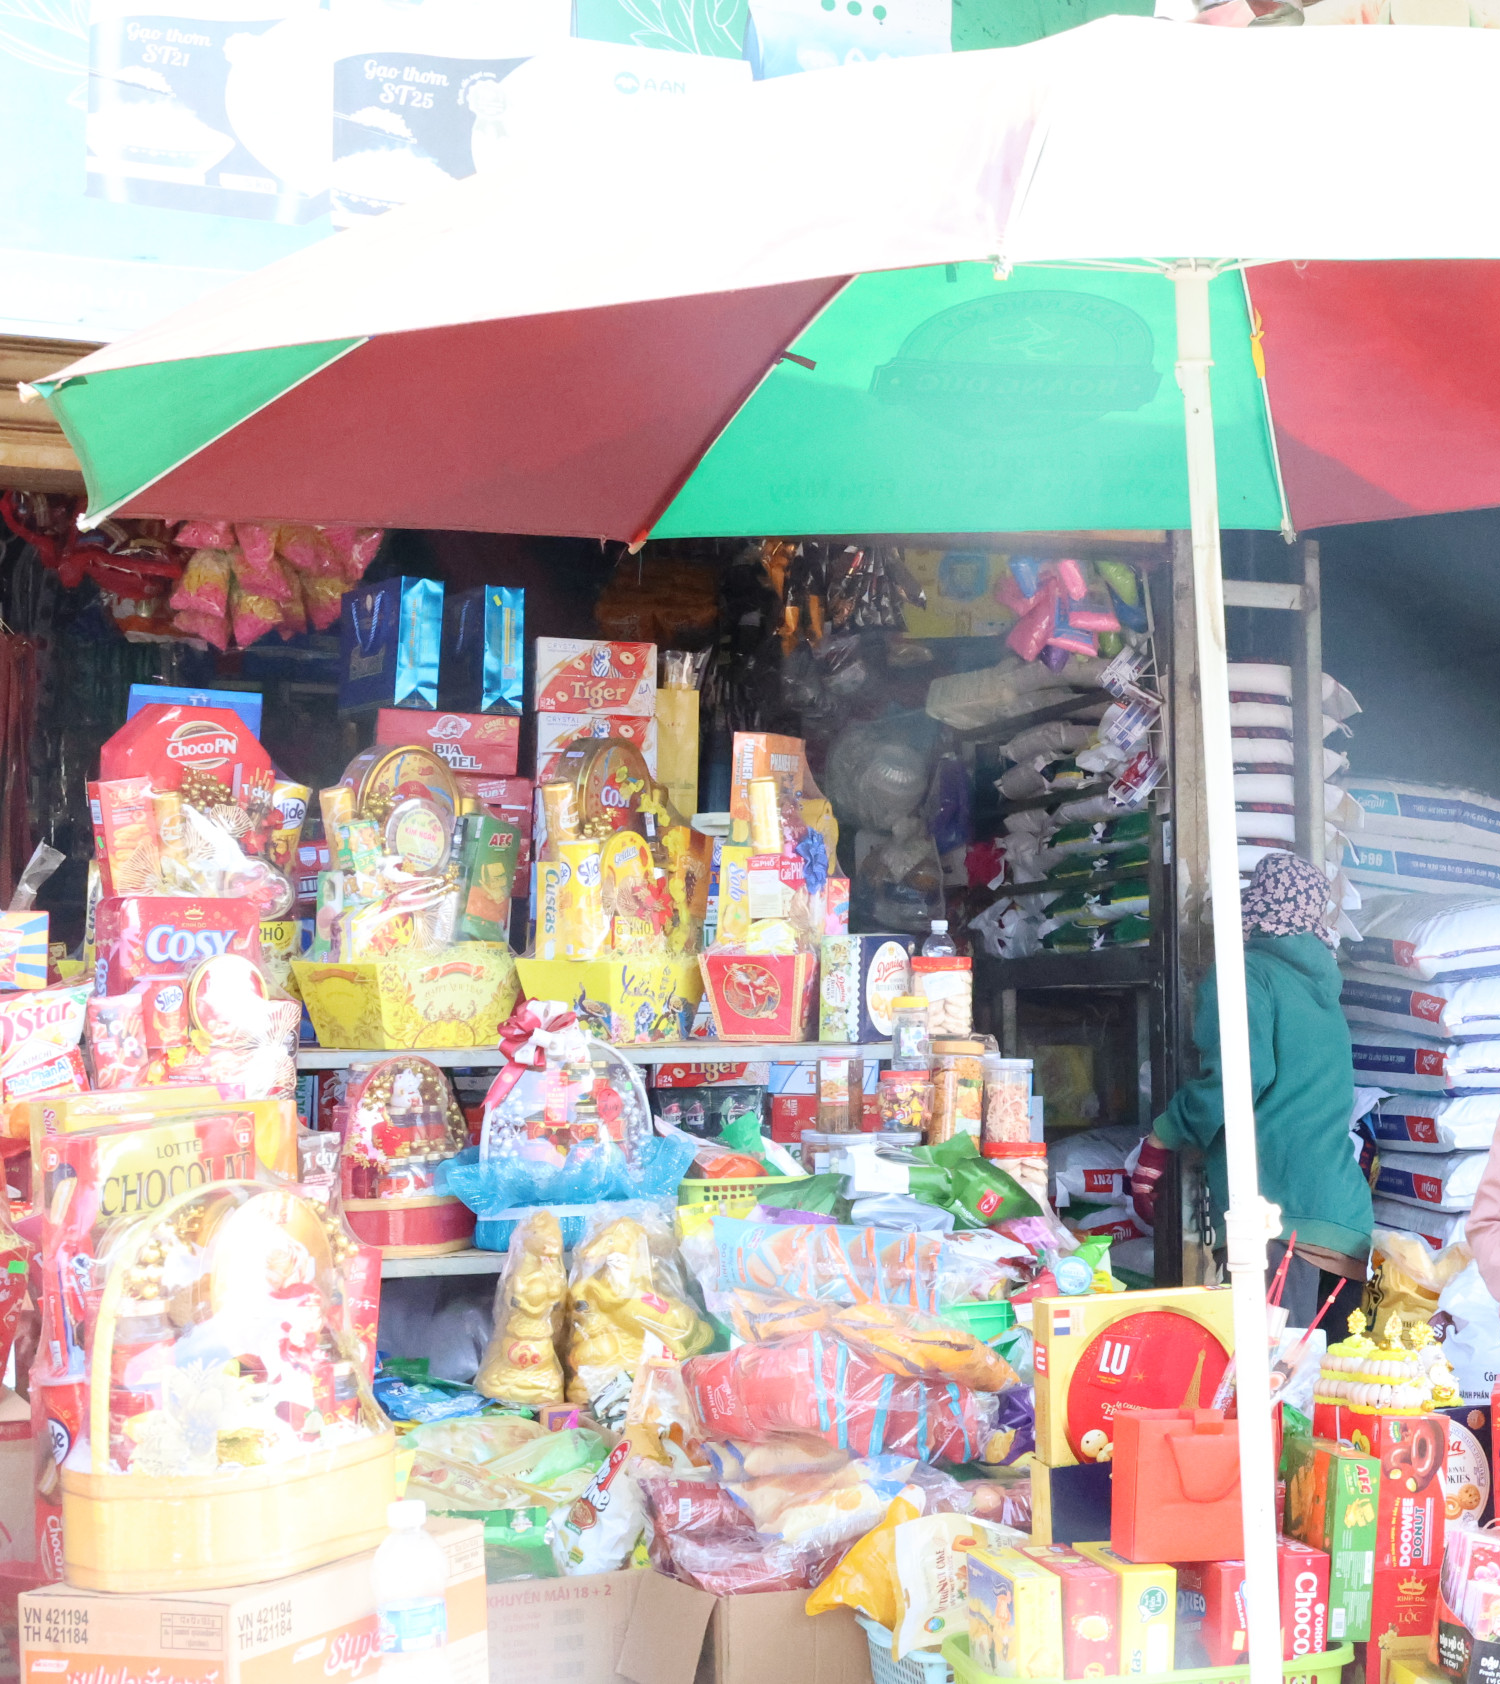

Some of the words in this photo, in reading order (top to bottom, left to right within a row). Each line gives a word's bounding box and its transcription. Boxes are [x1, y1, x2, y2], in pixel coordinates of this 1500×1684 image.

[126, 21, 162, 44] Gạo
[165, 28, 213, 48] thơm
[142, 44, 189, 67] ST21
[364, 59, 402, 84] Gạo
[403, 68, 450, 87] thơm
[379, 84, 434, 109] ST25
[570, 680, 626, 708] Tiger
[433, 743, 462, 755] BIA
[488, 832, 514, 847] AFC
[577, 854, 600, 886] Slid
[544, 869, 561, 934] Custas
[155, 988, 184, 1012] Slide
[156, 1139, 201, 1159] LOTTE
[1035, 1345, 1046, 1371] LU
[1099, 1340, 1131, 1376] LU
[1355, 1464, 1373, 1495] AFC
[1400, 1498, 1415, 1567] DOOWEE
[1412, 1507, 1425, 1558] DONUT
[604, 1584, 612, 1596] 2
[23, 1607, 42, 1624] VN
[45, 1608, 90, 1626] 421194
[237, 1613, 254, 1631] VN
[255, 1600, 292, 1624] 421194
[23, 1625, 42, 1643] TH
[45, 1627, 89, 1645] 421184
[238, 1631, 255, 1650] TH
[255, 1619, 293, 1643] 421184
[325, 1630, 386, 1678] Supe
